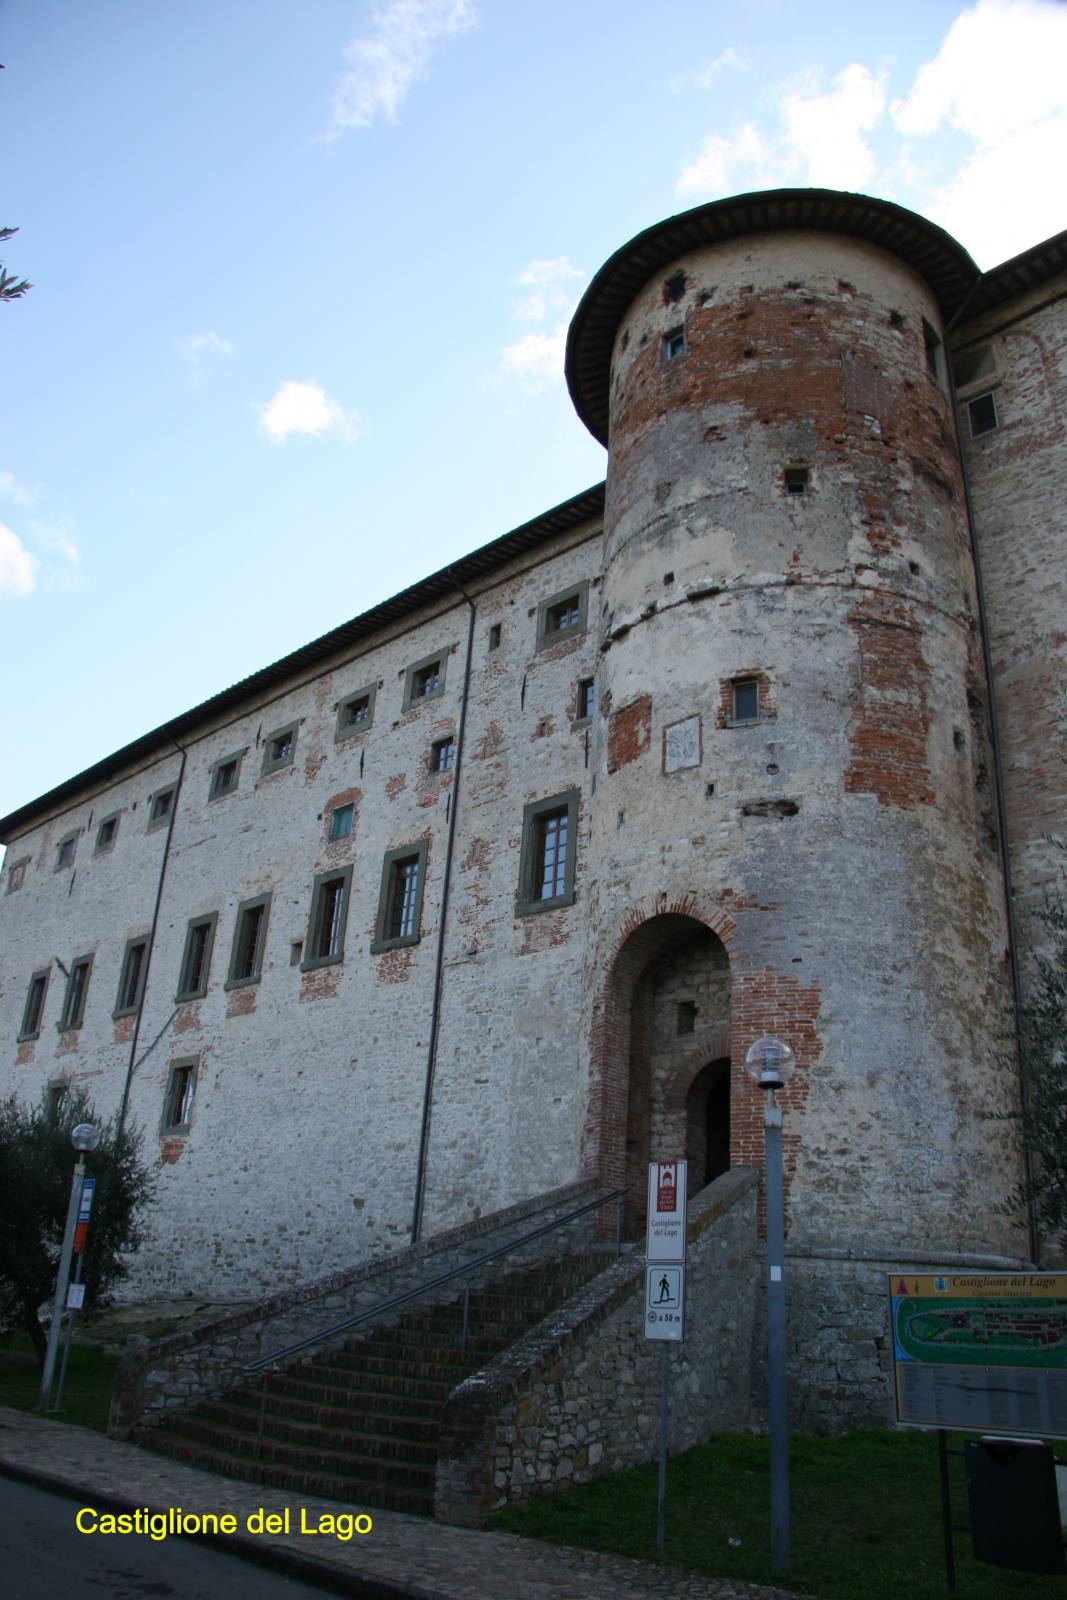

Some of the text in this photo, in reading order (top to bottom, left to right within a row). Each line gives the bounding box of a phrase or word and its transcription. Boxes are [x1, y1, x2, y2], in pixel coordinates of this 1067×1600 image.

[651, 1219, 682, 1228] Castiglione
[664, 1229, 678, 1238] Lago
[952, 1276, 1056, 1289] Castiglione del Lago
[664, 1313, 673, 1322] 50
